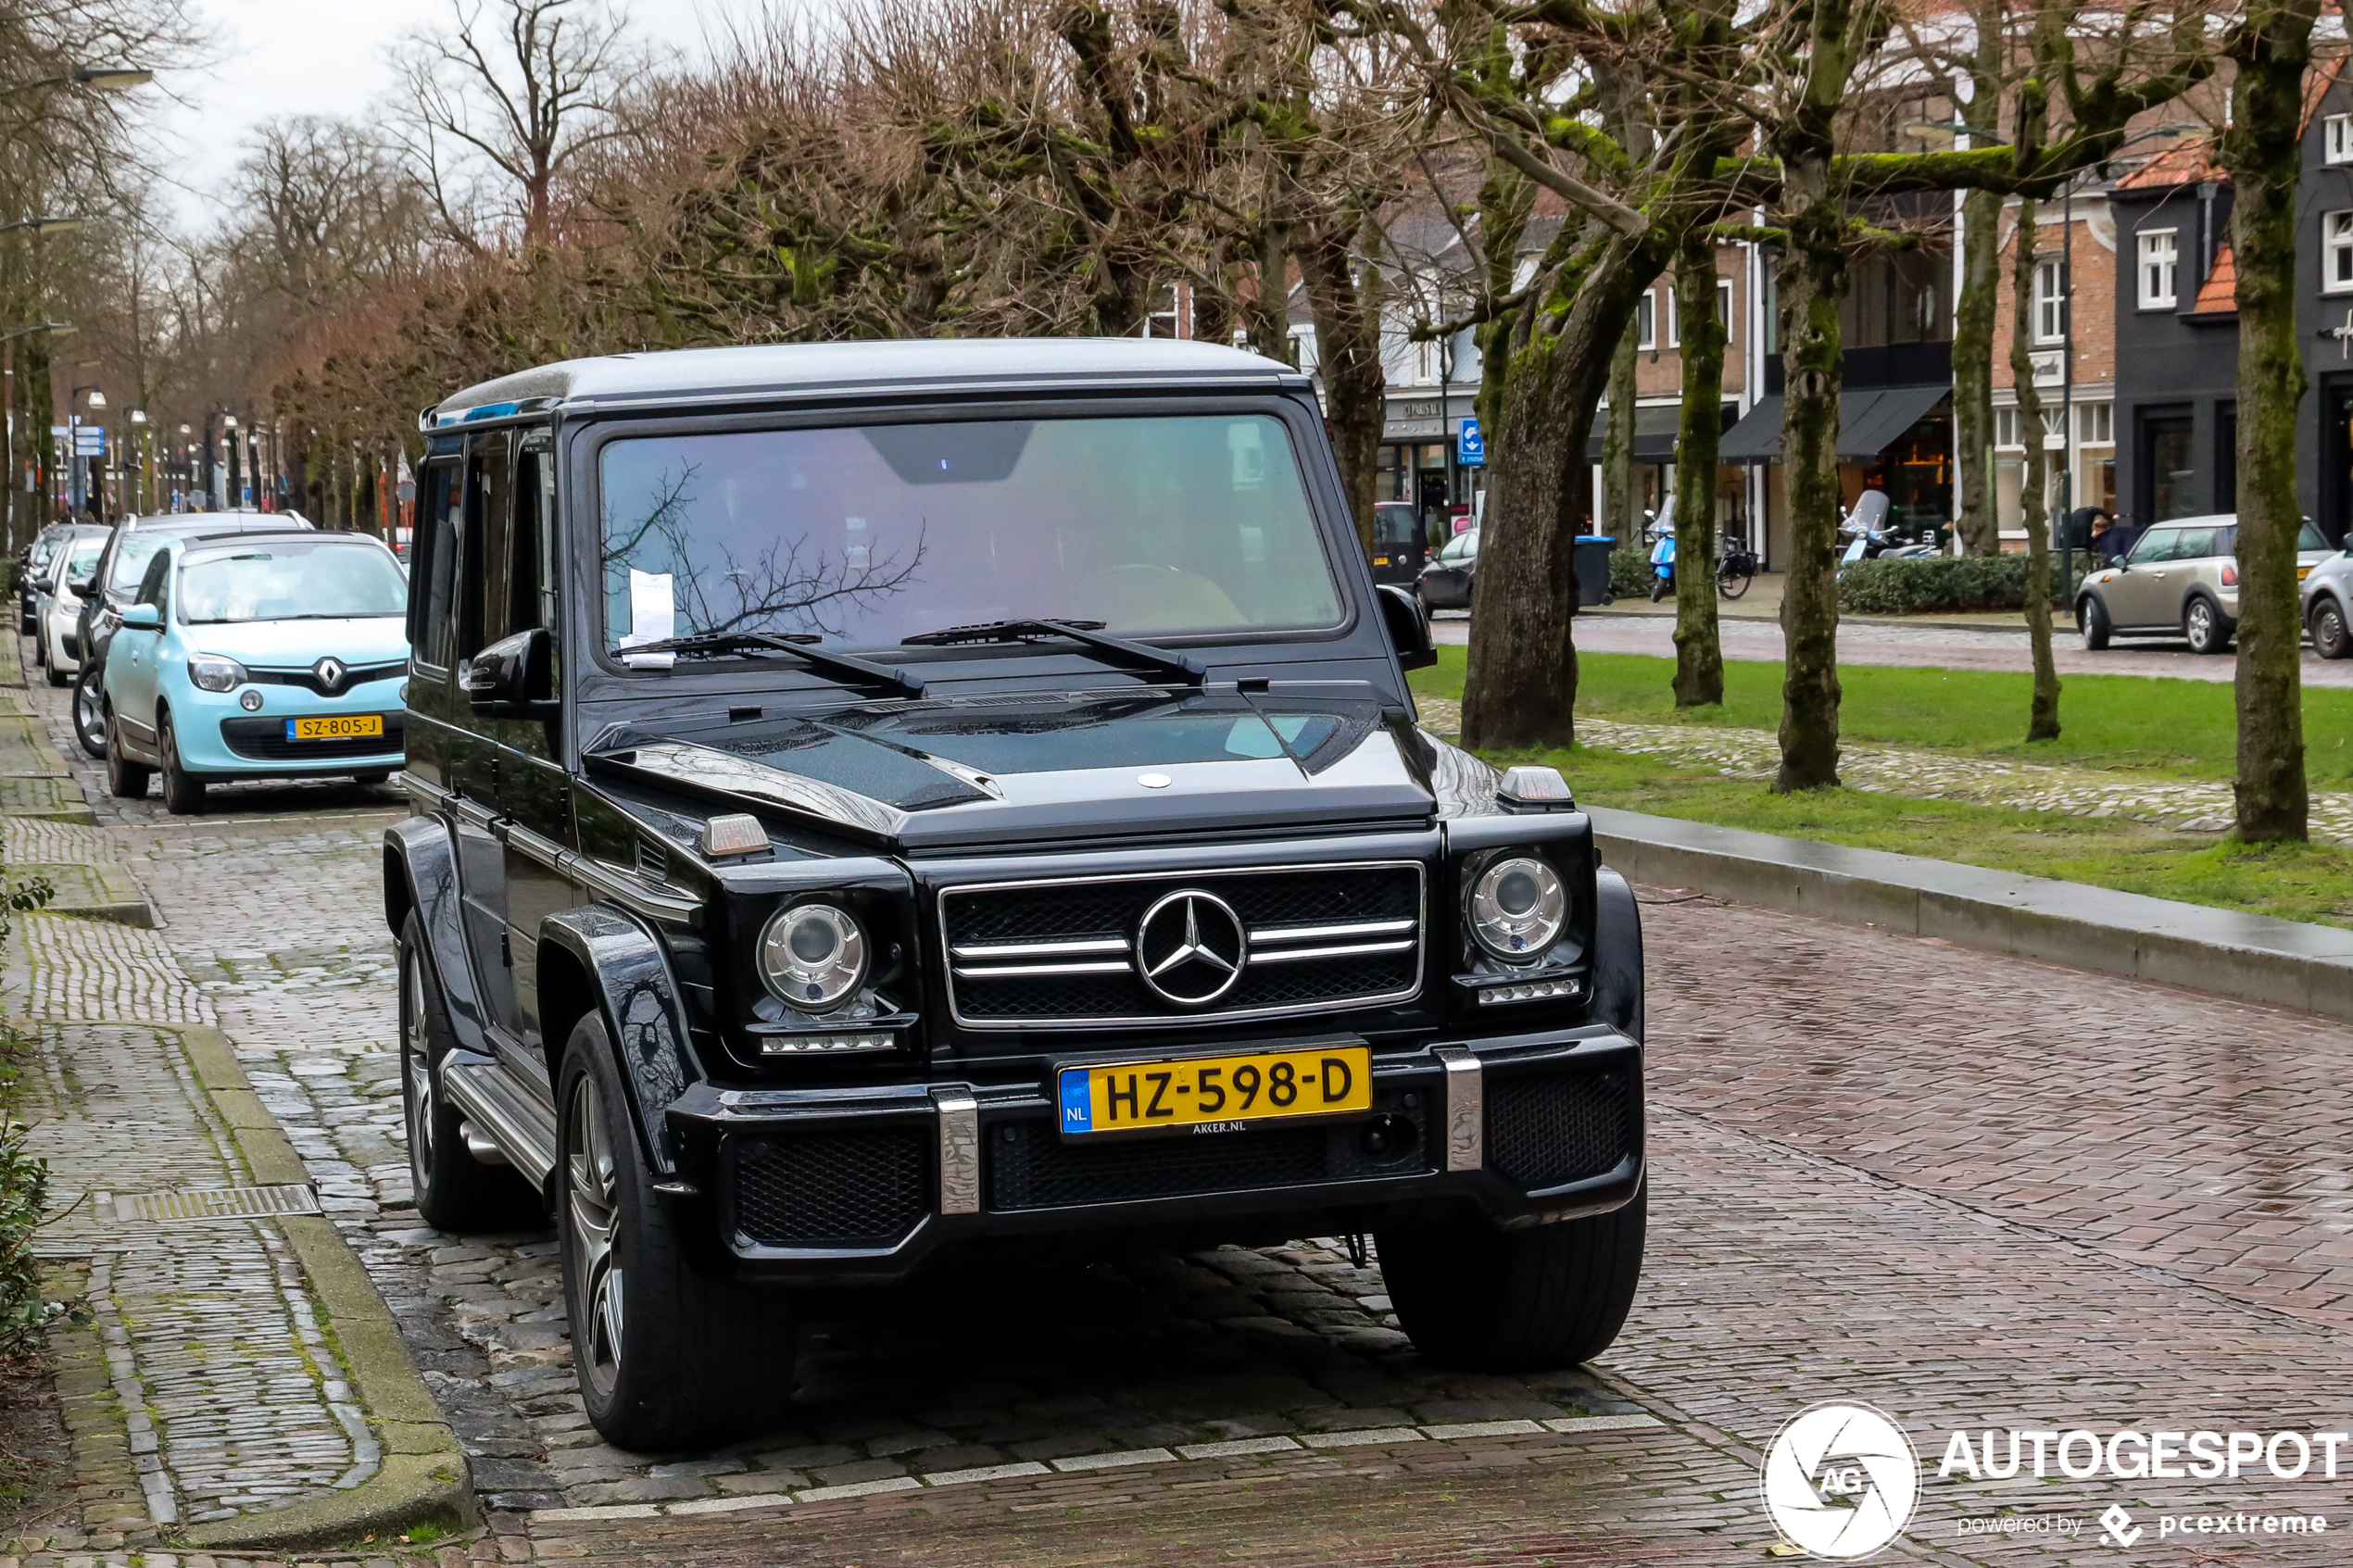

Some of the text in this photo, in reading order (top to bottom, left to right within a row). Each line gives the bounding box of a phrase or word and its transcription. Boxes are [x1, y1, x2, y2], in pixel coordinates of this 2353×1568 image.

[303, 719, 376, 735] SZ-805-J
[1107, 1058, 1353, 1122] HZ-598-D
[1066, 1107, 1088, 1122] NL
[1192, 1121, 1246, 1135] AKKER.NL
